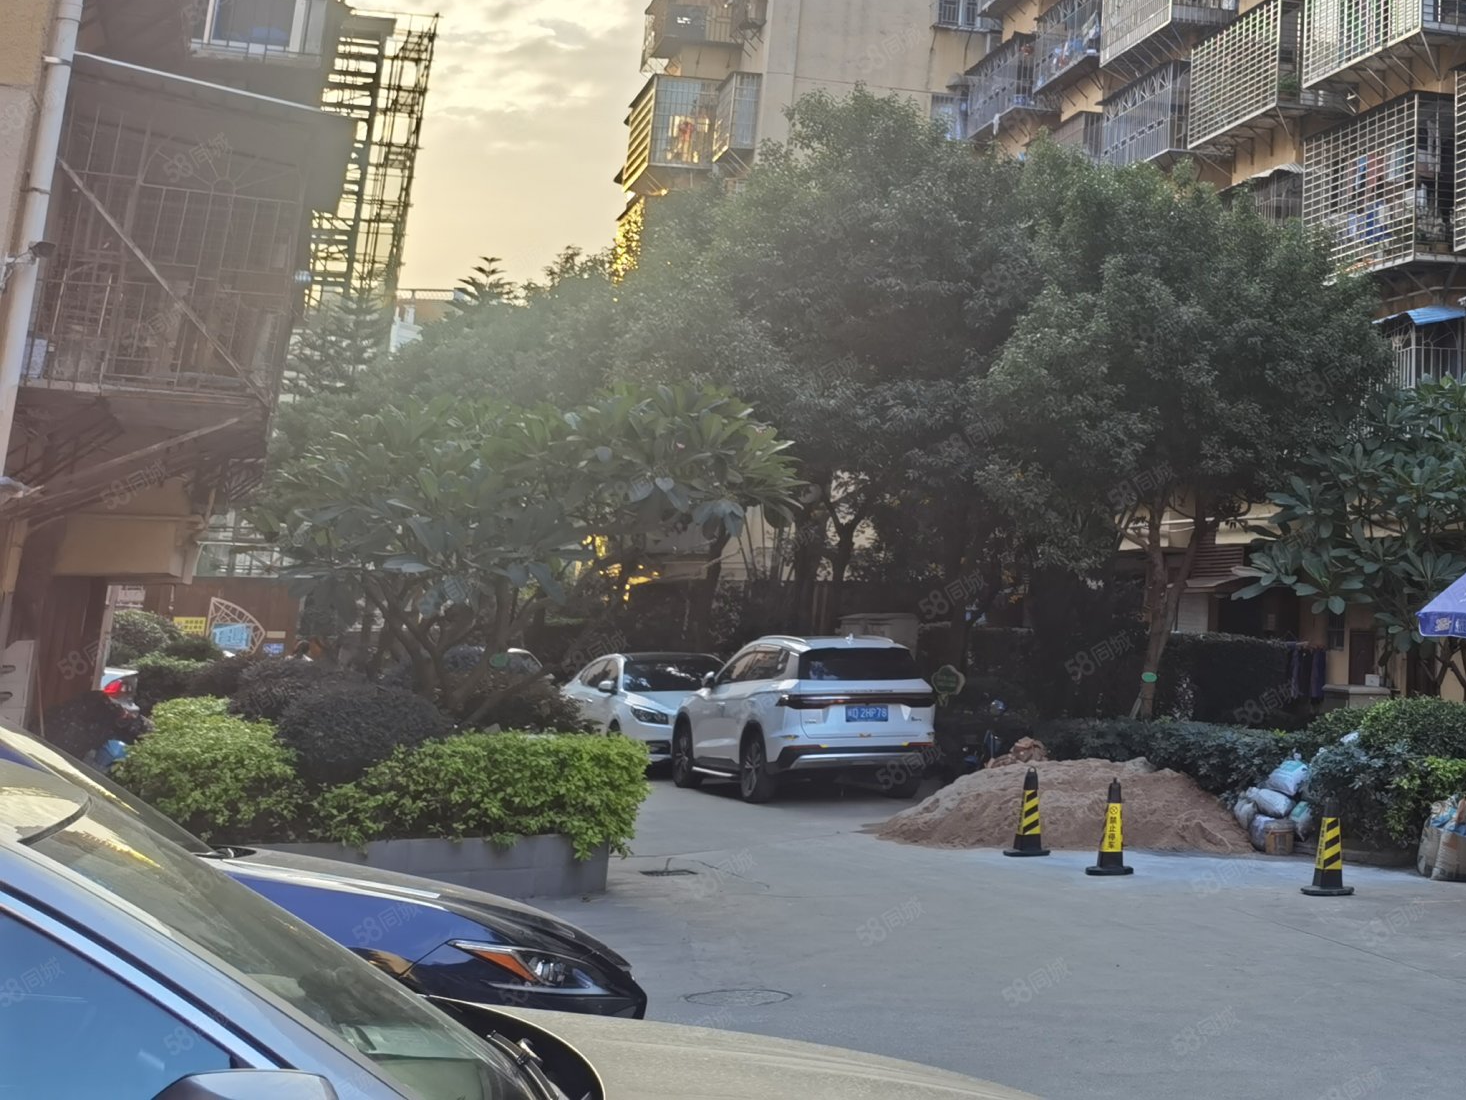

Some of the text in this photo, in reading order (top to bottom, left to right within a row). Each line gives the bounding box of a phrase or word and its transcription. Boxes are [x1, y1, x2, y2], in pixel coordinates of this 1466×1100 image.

[860, 707, 887, 718] 2HP78
[1108, 816, 1118, 850] 禁止停车
